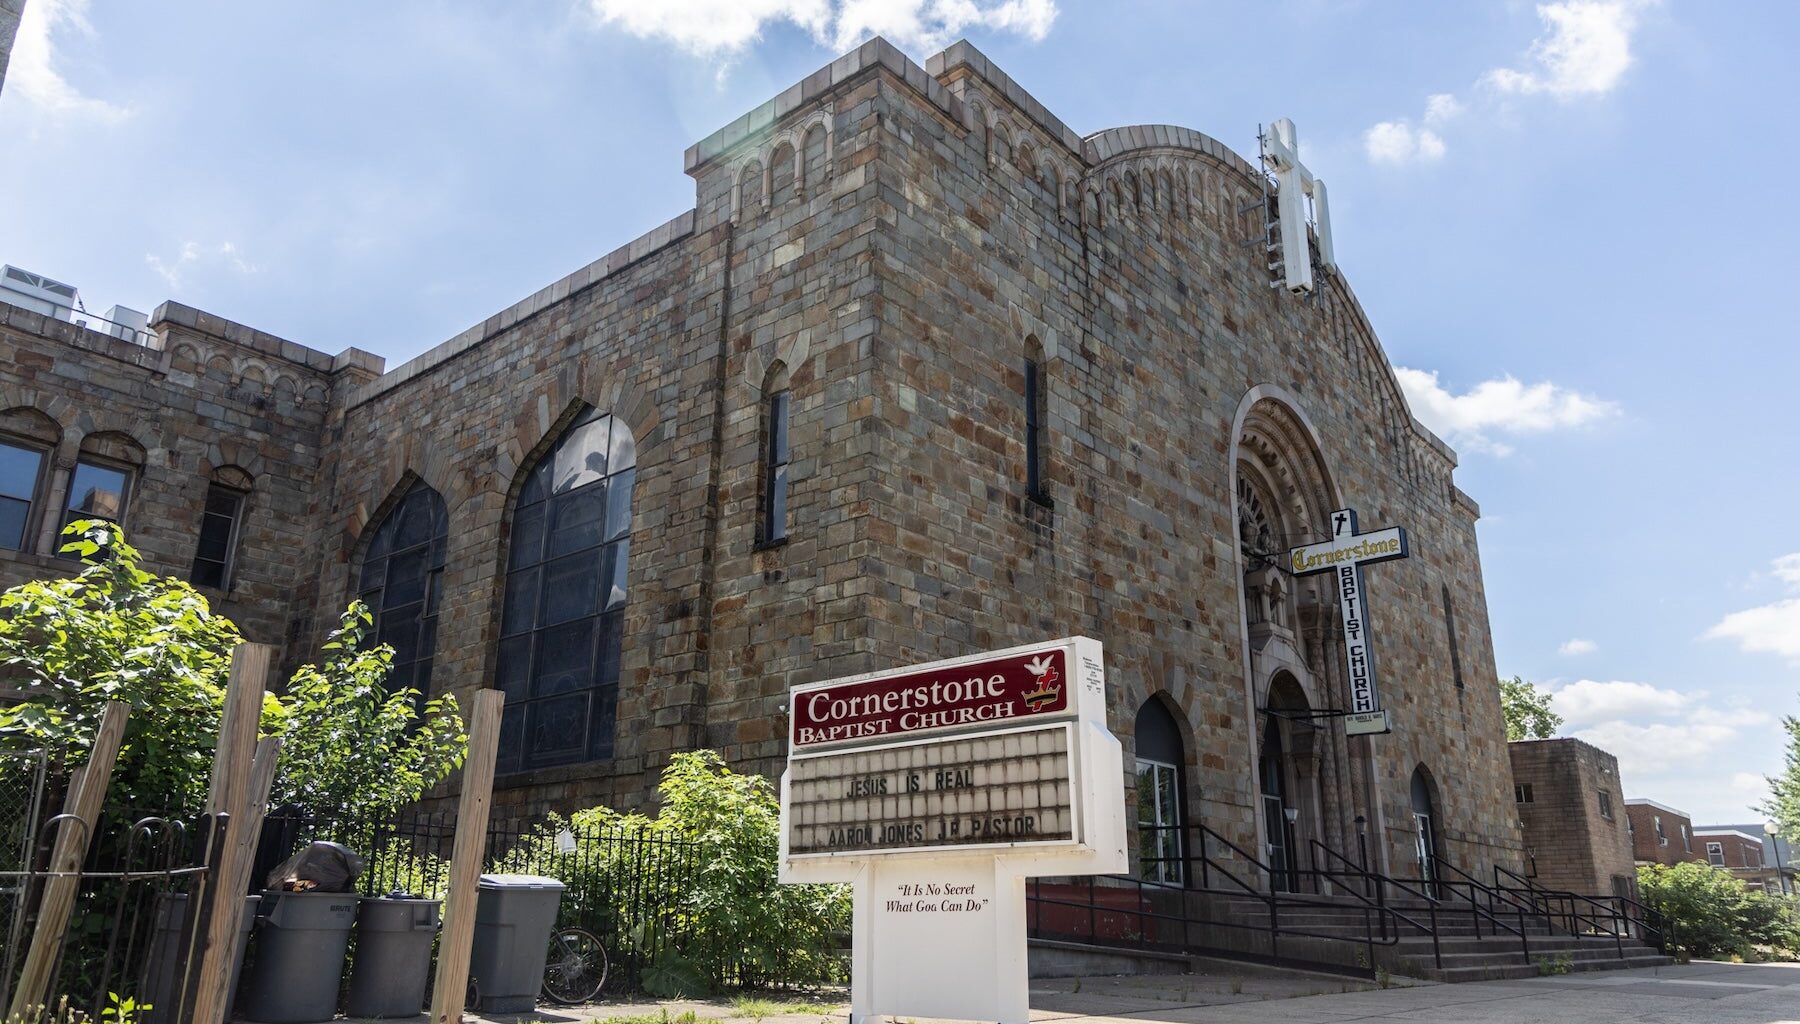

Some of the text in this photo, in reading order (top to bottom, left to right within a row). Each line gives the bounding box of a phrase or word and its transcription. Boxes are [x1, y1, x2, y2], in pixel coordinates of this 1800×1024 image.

[1292, 538, 1399, 571] Cornerstone
[1341, 567, 1359, 640] BAPTIST
[1350, 645, 1370, 711] CHURCH
[808, 674, 1006, 723] Cornerstone
[798, 701, 1015, 744] BAPTIST CHURCH
[847, 770, 974, 798] JESUS IS REAL
[829, 827, 872, 847] AARON
[879, 824, 923, 844] JONES
[972, 816, 1035, 838] PASTOR
[914, 884, 923, 896] Is
[926, 884, 941, 896] No
[944, 883, 975, 895] Secret
[886, 901, 913, 913] What
[941, 899, 962, 912] Can
